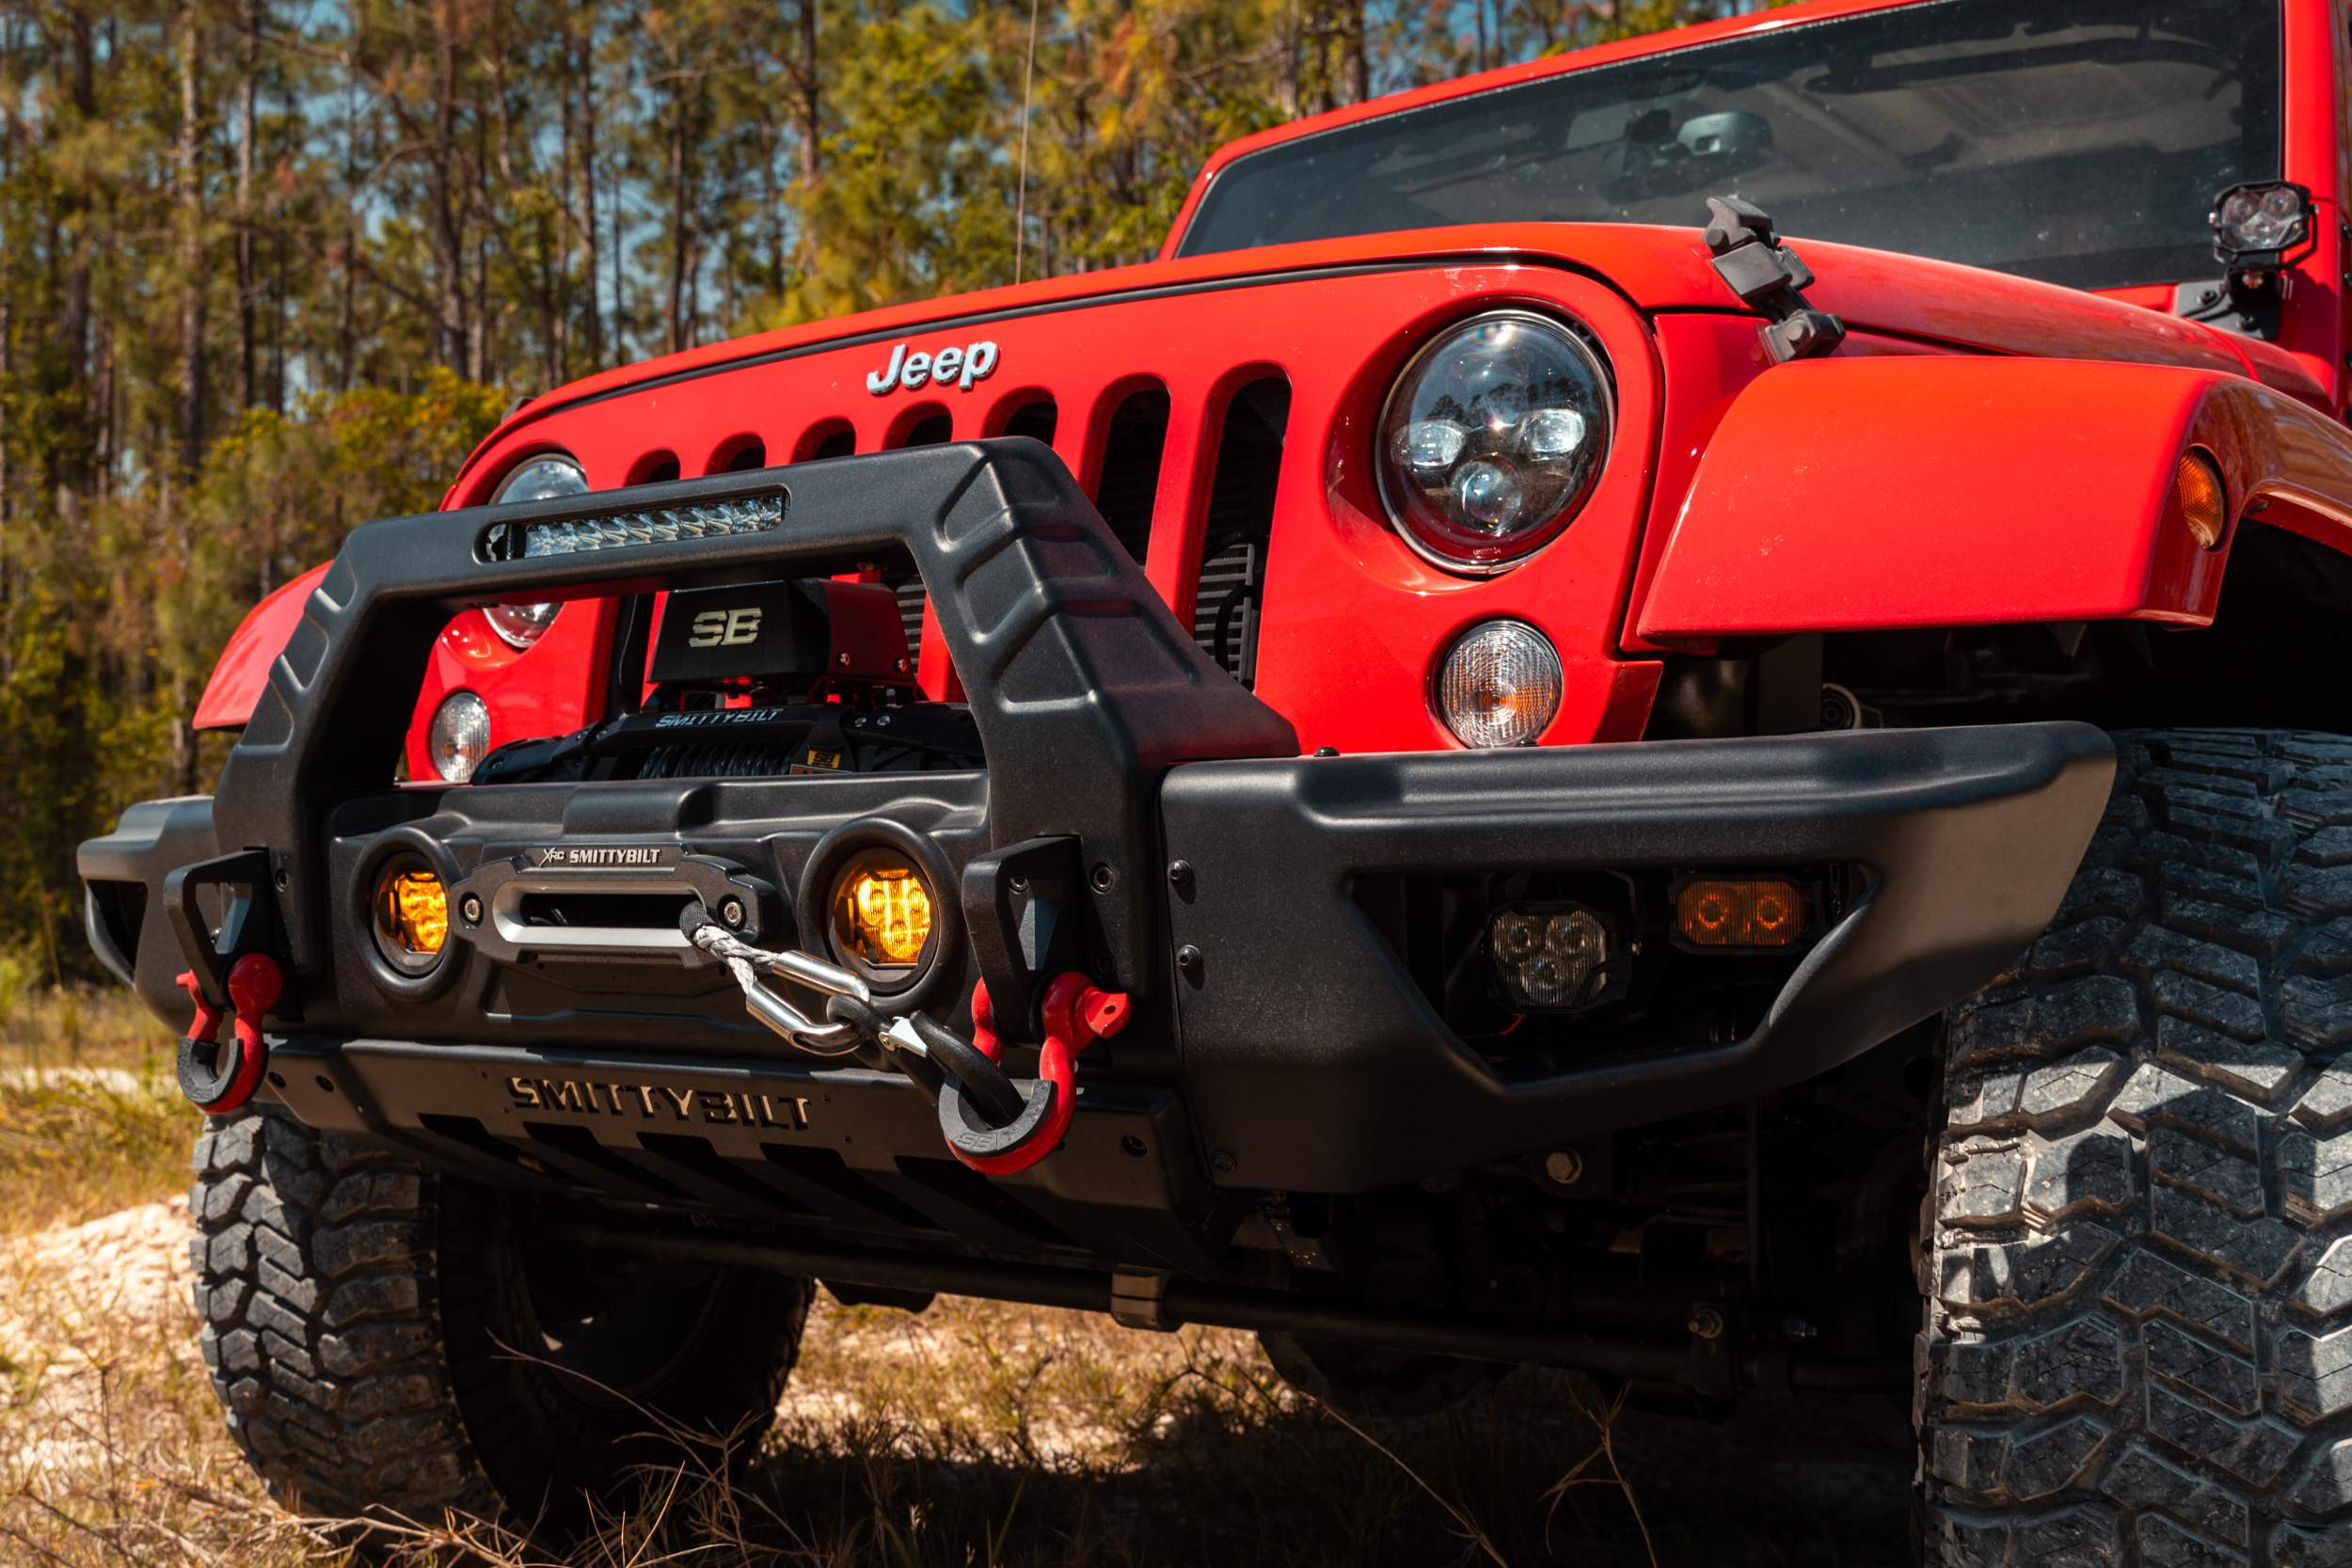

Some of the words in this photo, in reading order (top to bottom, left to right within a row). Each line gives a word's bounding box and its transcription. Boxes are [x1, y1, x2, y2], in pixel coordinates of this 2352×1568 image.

[866, 341, 999, 394] Jeep
[689, 608, 762, 647] SB
[656, 708, 784, 727] SMITTYBILT
[538, 847, 564, 867] XRC
[569, 849, 660, 863] SMITTYBILT
[506, 1077, 812, 1131] SMITTYBILT
